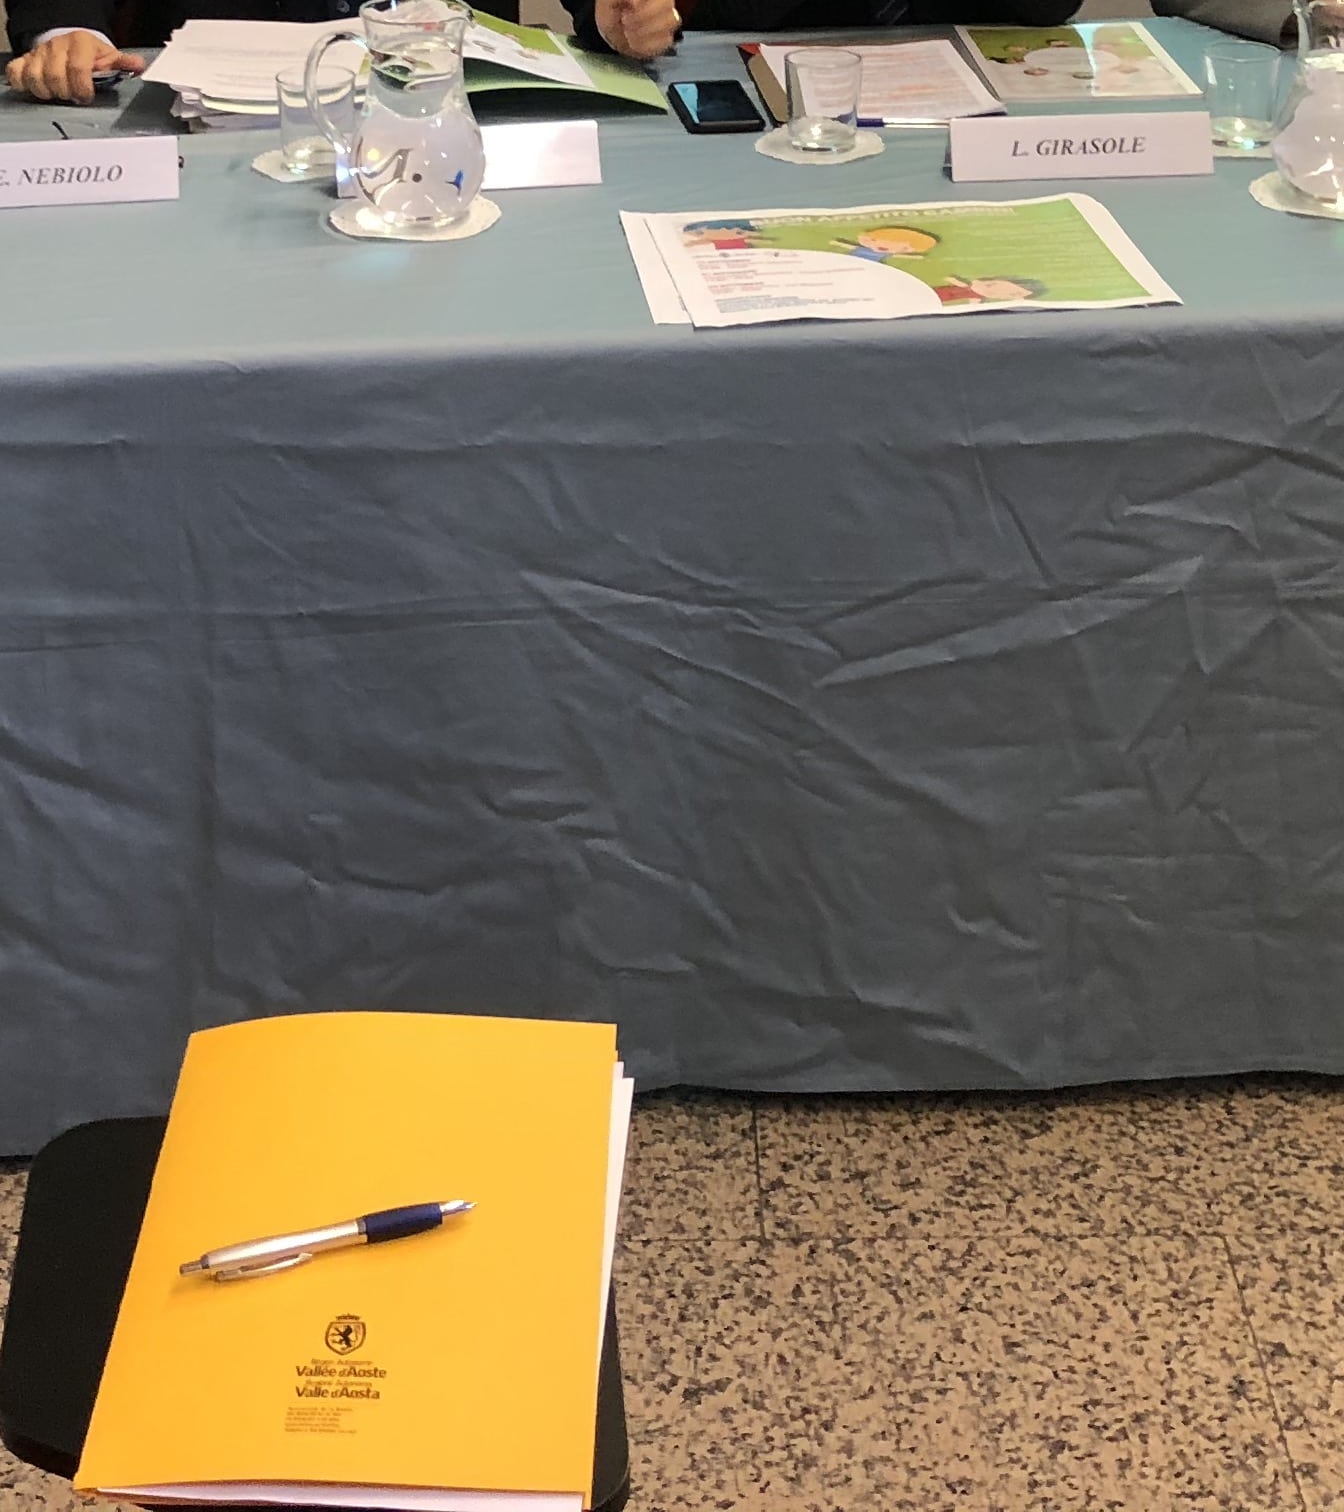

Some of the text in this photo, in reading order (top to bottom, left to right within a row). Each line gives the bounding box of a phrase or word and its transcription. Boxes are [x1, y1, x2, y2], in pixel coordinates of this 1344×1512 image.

[1011, 136, 1147, 157] L. GIRASOLE
[17, 164, 123, 186] NEBIOLO
[295, 1365, 337, 1377] Vallée
[295, 1386, 329, 1398] Valle
